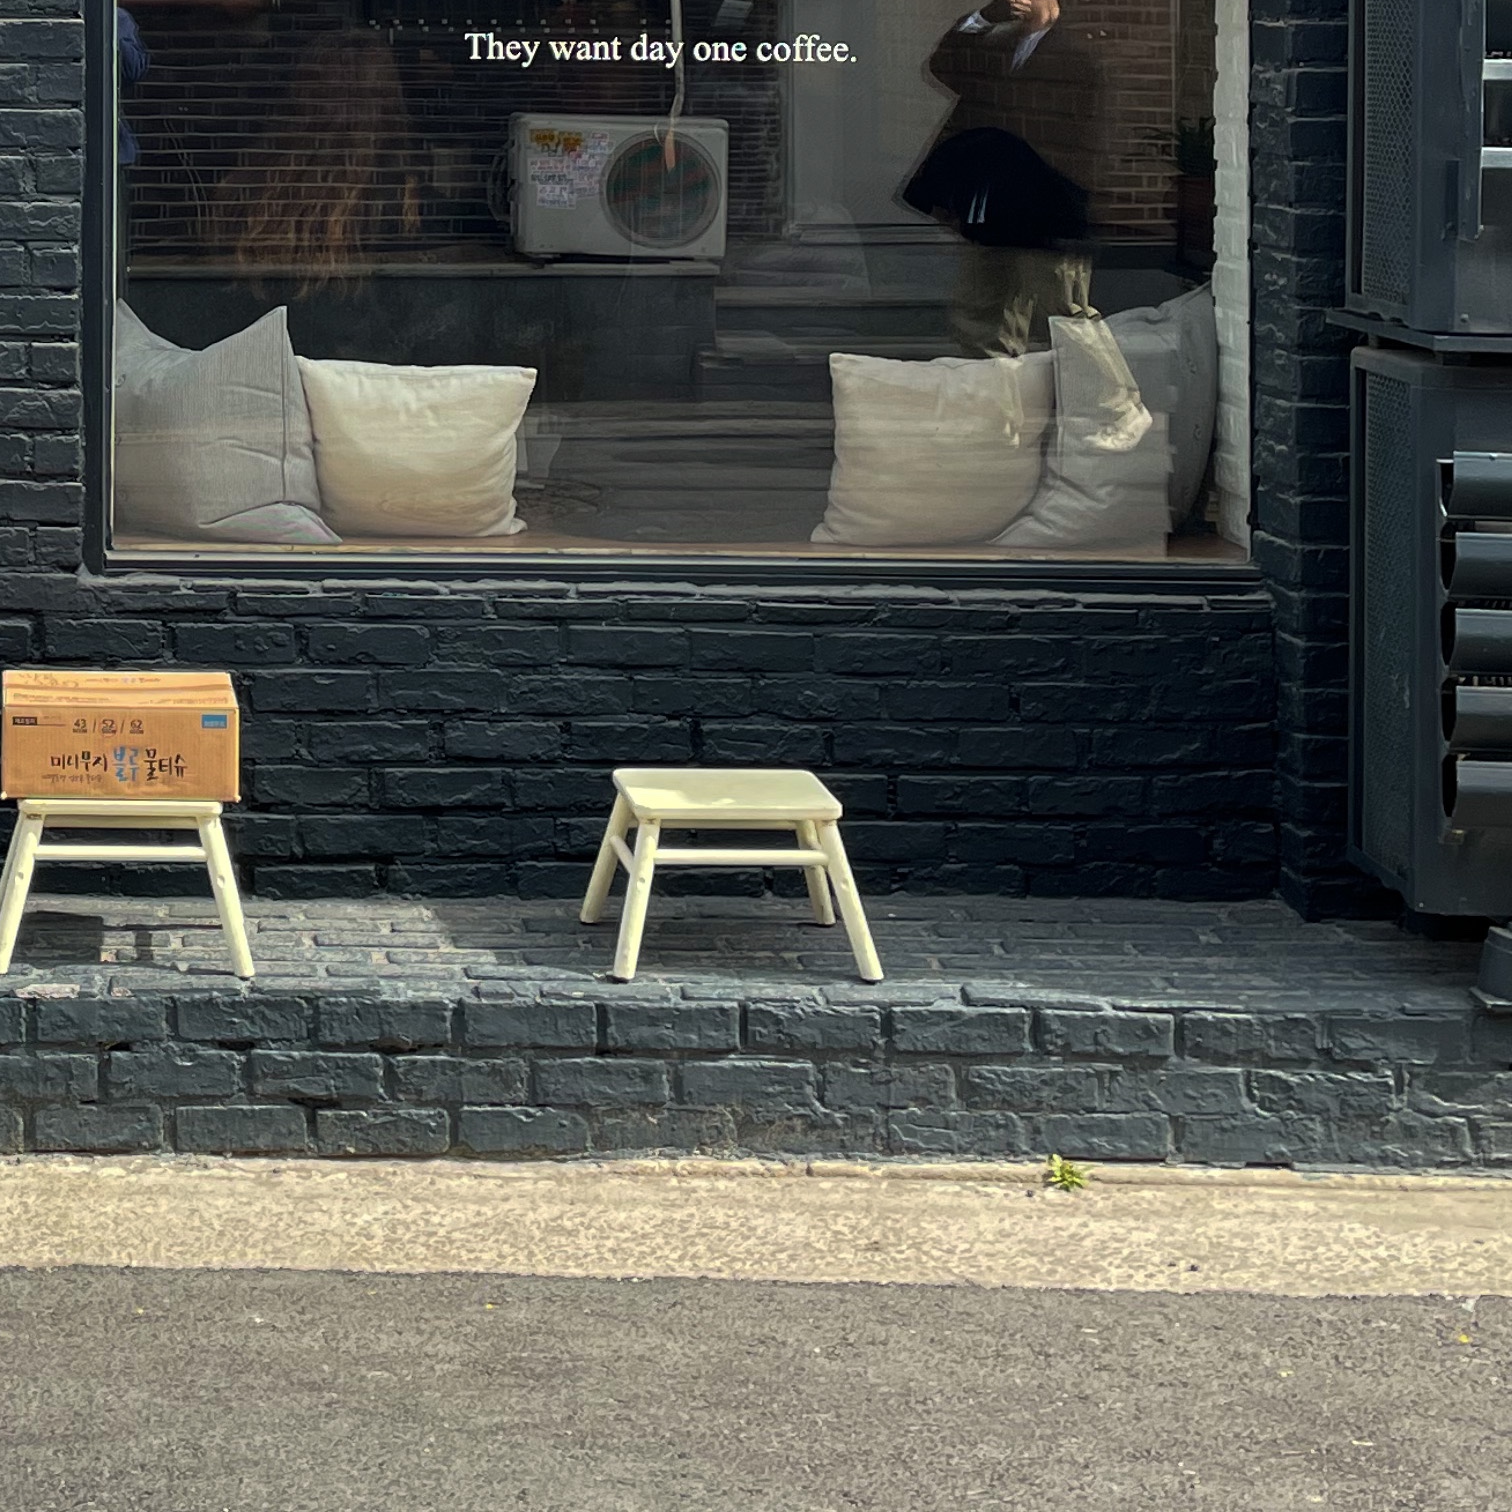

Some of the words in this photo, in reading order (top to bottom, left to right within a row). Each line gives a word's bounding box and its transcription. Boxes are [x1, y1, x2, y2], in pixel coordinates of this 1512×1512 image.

[464, 32, 540, 68] They
[549, 36, 622, 62] want
[630, 33, 685, 69] day
[694, 41, 747, 62] one
[756, 34, 857, 62] coffee.
[74, 719, 87, 729] 43
[102, 719, 115, 729] 52
[50, 751, 108, 772] 미니무지
[113, 746, 140, 782] 블루
[143, 748, 188, 781] 물티슈
